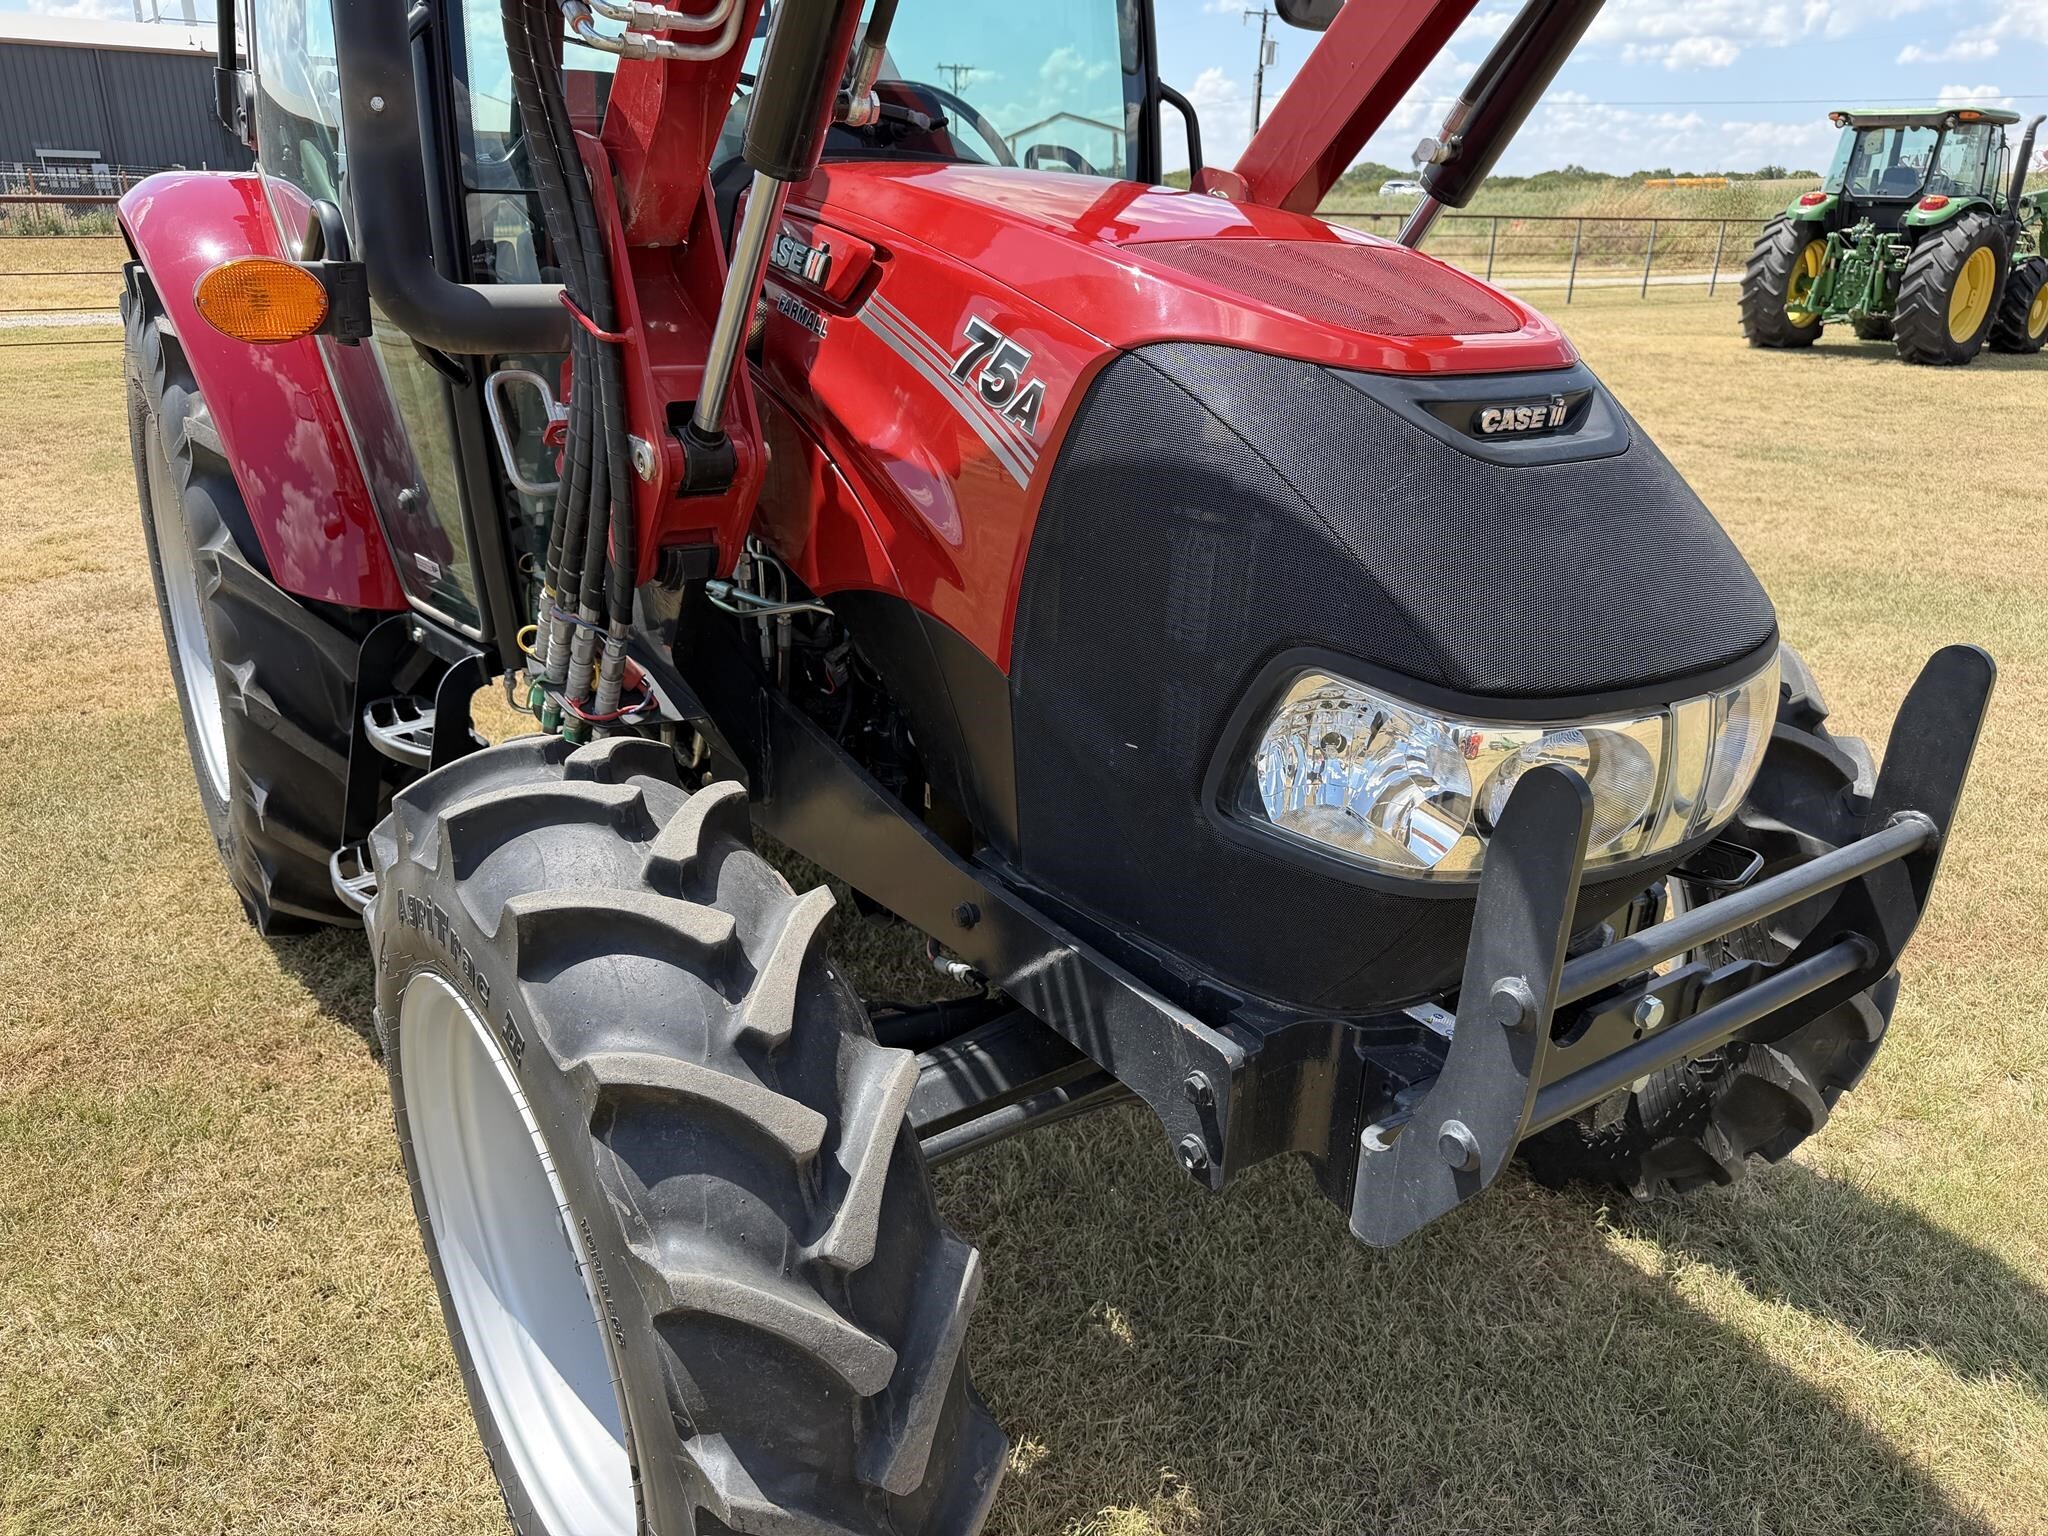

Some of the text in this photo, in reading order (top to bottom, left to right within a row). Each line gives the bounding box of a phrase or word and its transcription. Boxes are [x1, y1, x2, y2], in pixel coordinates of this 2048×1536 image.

[777, 293, 828, 339] FARMALL
[949, 314, 1047, 437] 75A
[1481, 405, 1547, 433] CASE
[397, 887, 490, 1008] AgriTrac
